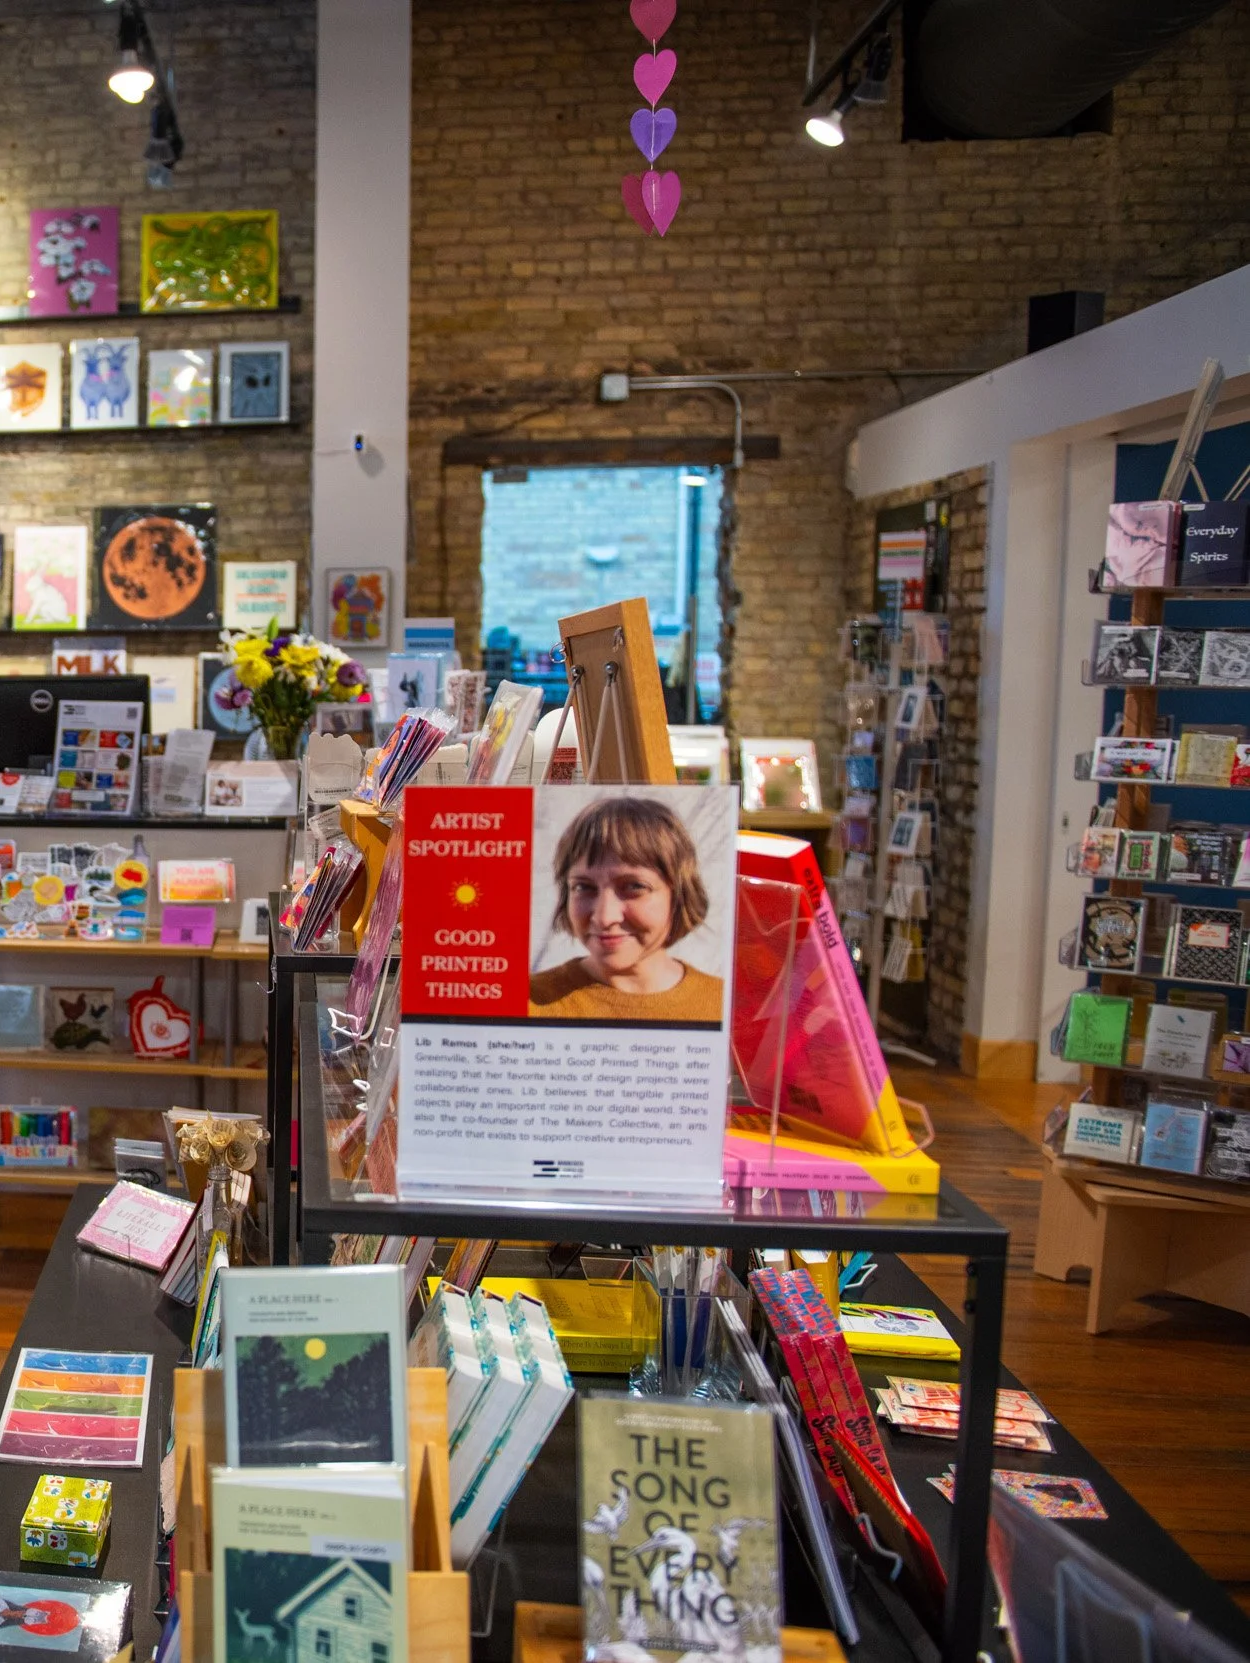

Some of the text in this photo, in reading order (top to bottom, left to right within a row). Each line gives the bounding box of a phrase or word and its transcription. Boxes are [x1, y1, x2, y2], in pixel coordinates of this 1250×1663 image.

[1186, 525, 1238, 539] Everyday
[1190, 552, 1228, 564] Spirits
[431, 812, 505, 830] ARTIST
[408, 840, 527, 858] SPOTLIGHT
[803, 867, 823, 911] extra
[434, 929, 496, 947] GOOD
[817, 911, 840, 949] bold
[421, 955, 508, 973] PRINTED
[425, 981, 503, 1000] THINGS
[415, 1038, 431, 1047] Lib
[442, 1039, 478, 1049] Ramos
[488, 1041, 536, 1050] (she/her)
[581, 1043, 620, 1052] graphic
[631, 1044, 676, 1055] designer
[687, 1045, 711, 1054] from
[414, 1053, 469, 1064] Greenville,
[500, 1055, 519, 1065] She
[525, 1057, 561, 1066] started
[567, 1058, 595, 1067] Good
[601, 1058, 639, 1068] Printed
[645, 1059, 680, 1070] Things
[686, 1061, 710, 1070] after
[414, 1069, 458, 1079] realizing
[462, 1070, 481, 1079] that
[486, 1071, 503, 1079] her
[507, 1071, 546, 1080] favorite
[549, 1072, 577, 1082] kinds
[583, 1074, 593, 1082] of
[597, 1074, 632, 1084] design
[636, 1075, 678, 1086] projects
[414, 1084, 710, 1101] collaborative ones. Lib believes that tangible printed
[414, 1099, 451, 1109] objects
[455, 1101, 477, 1111] play
[497, 1101, 546, 1112] important
[550, 1102, 570, 1111] role
[573, 1103, 583, 1111] in
[586, 1105, 604, 1113] our
[608, 1104, 640, 1115] digital
[644, 1105, 675, 1115] world.
[679, 1105, 708, 1115] She's
[414, 1114, 435, 1122] also
[440, 1114, 457, 1123] the
[463, 1115, 518, 1126] co-founder
[524, 1117, 535, 1126] of
[540, 1117, 560, 1127] The
[566, 1118, 603, 1128] Makers
[609, 1119, 663, 1131] Collective,
[688, 1123, 707, 1131] arts
[1077, 1125, 1122, 1136] DEEP SEA
[1078, 1117, 1123, 1129] EXTREME
[413, 1129, 694, 1146] non-profit that exists to support creative entrepreneurs.
[258, 1296, 290, 1305] PLACE
[291, 1295, 321, 1304] HERE
[563, 1340, 583, 1348] There
[595, 1341, 617, 1350] Always
[629, 1433, 708, 1470] THE
[611, 1469, 731, 1509] SONG
[248, 1505, 282, 1516] PLACE
[287, 1506, 318, 1519] HERE
[644, 1509, 700, 1541] OF
[610, 1546, 739, 1586] EVERY
[611, 1584, 740, 1627] THING
